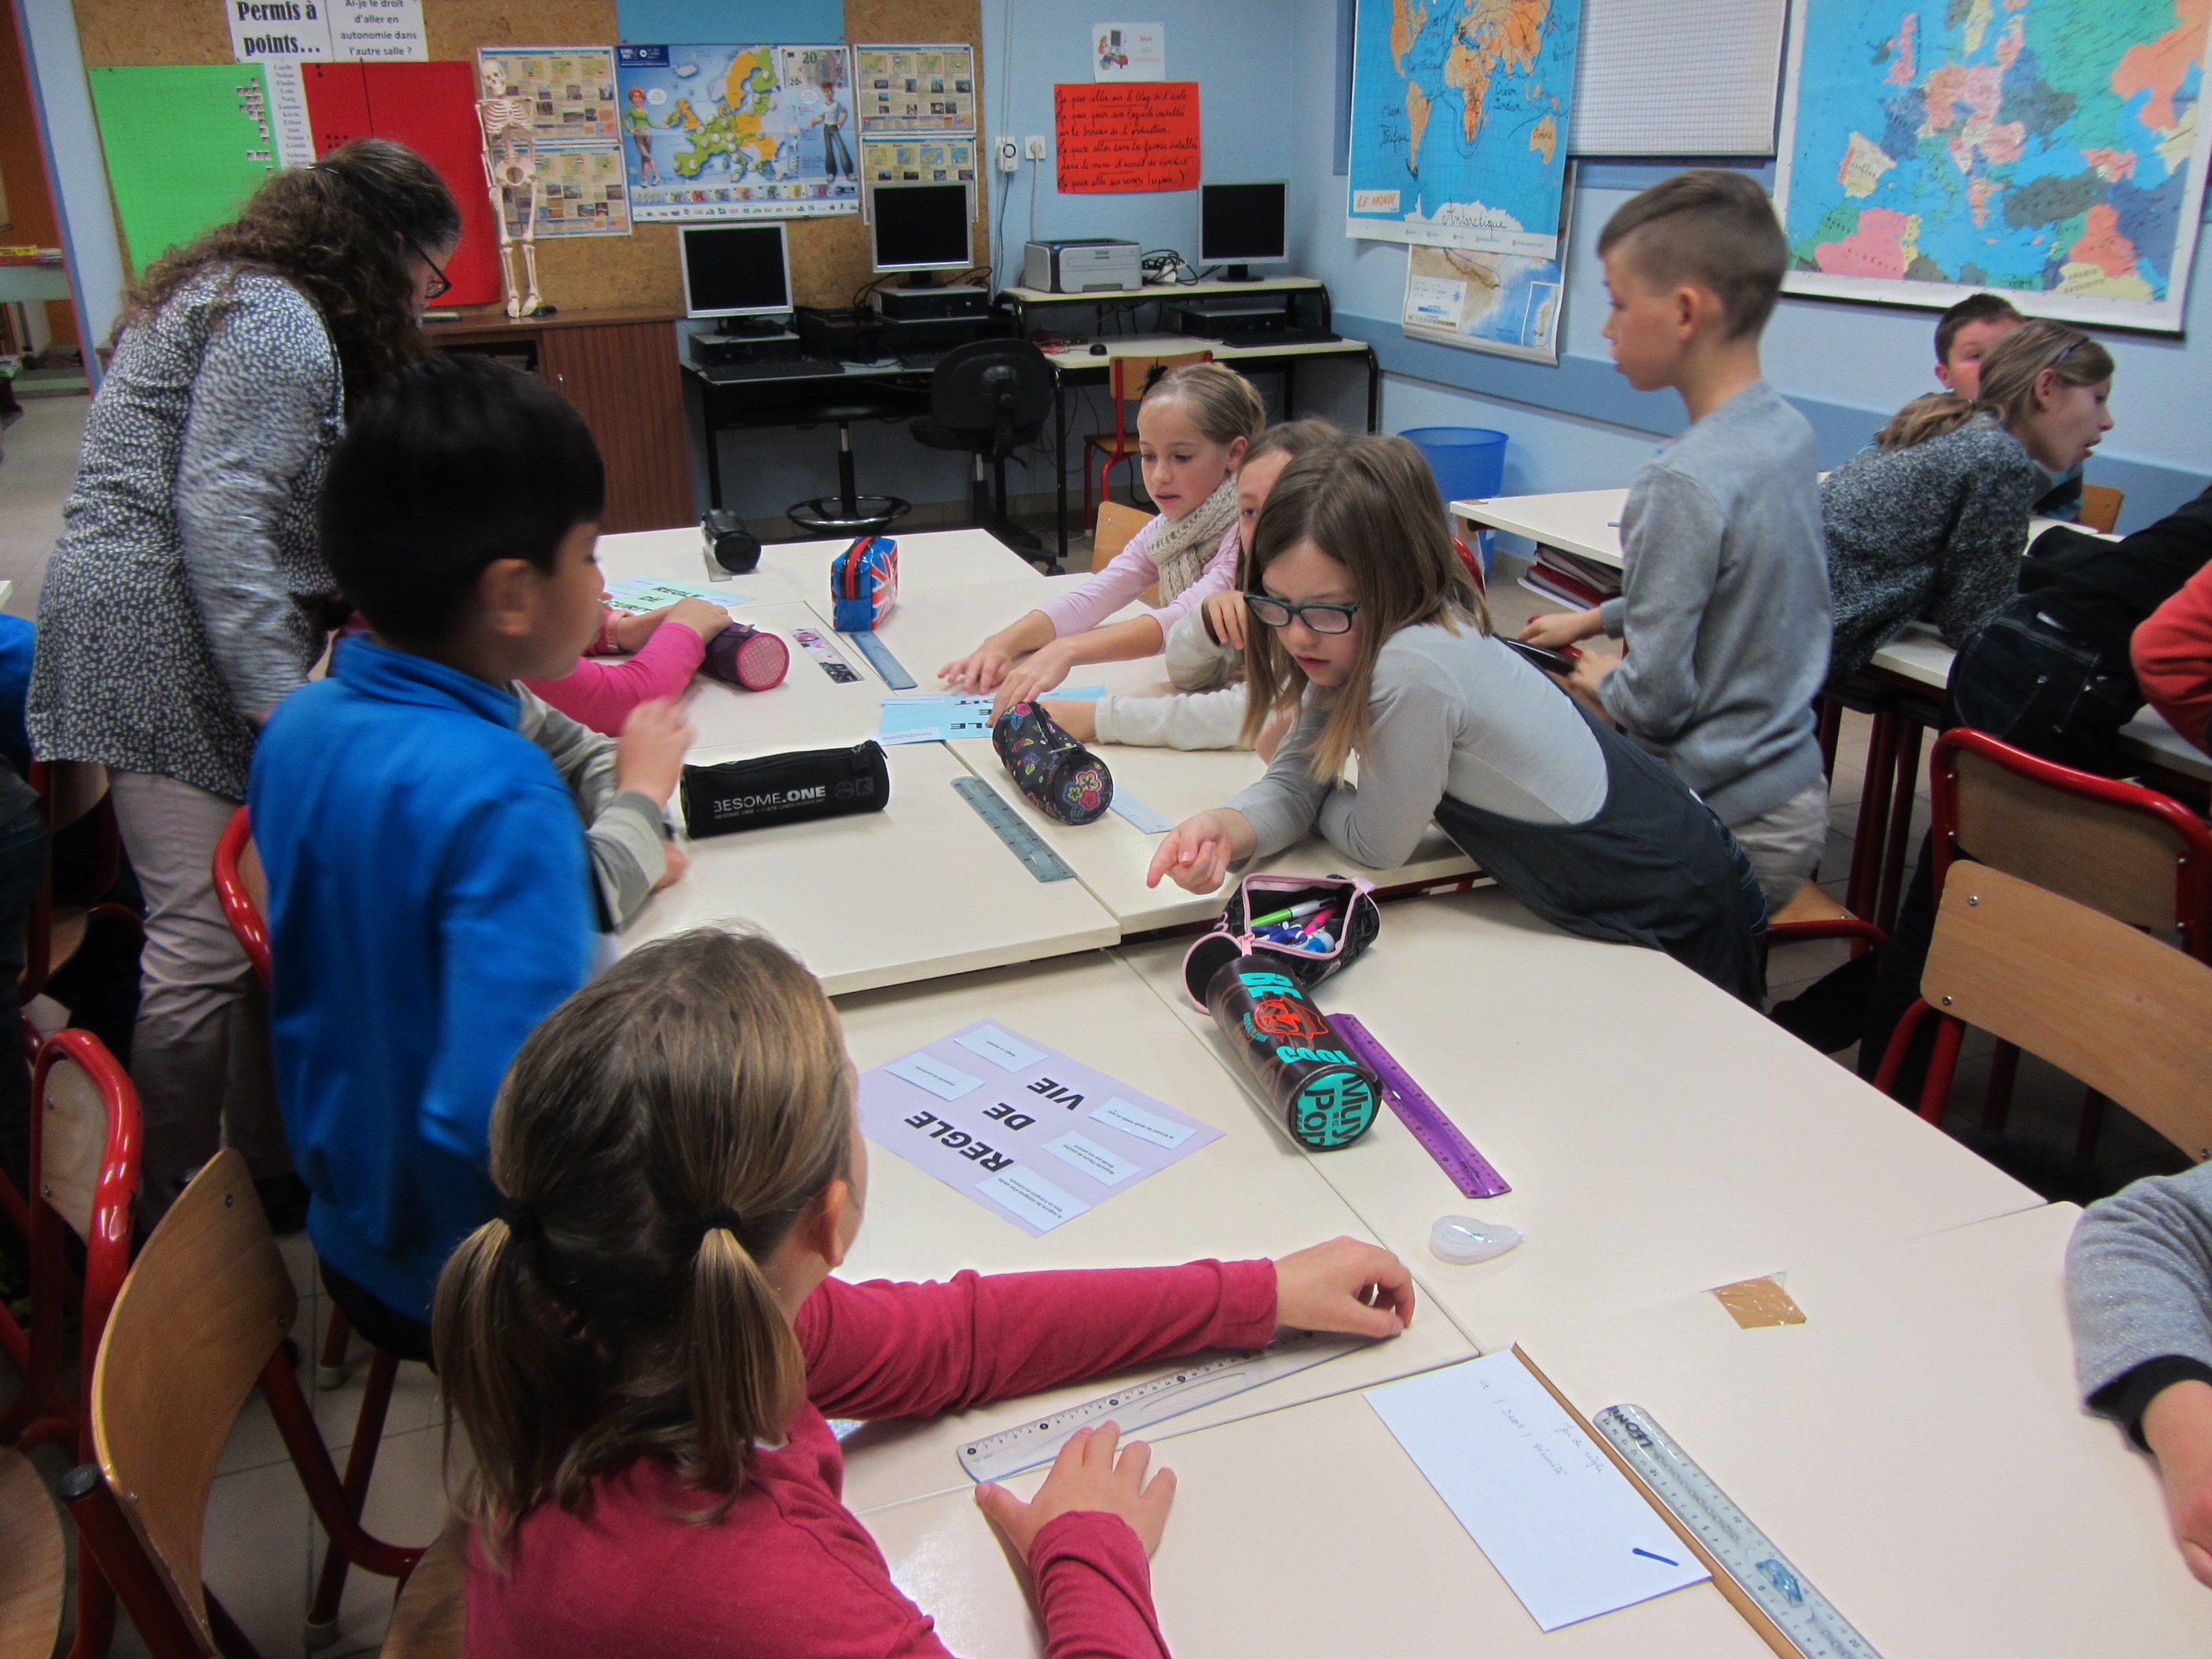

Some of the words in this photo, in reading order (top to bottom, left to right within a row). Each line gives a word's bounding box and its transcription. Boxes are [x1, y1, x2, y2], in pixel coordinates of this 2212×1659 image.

[237, 2, 301, 20] Permis
[306, 0, 317, 20] à
[341, 31, 394, 40] autonomie
[397, 31, 417, 39] dans
[350, 47, 380, 56] l'autre
[383, 46, 405, 55] salle
[802, 52, 817, 64] 20
[1357, 196, 1368, 207] LE
[1442, 199, 1507, 240] Antarctique
[1238, 972, 1303, 1000] BE
[1025, 1077, 1085, 1110] VIE
[982, 1102, 1035, 1131] DE
[904, 1111, 1013, 1173] REGLE
